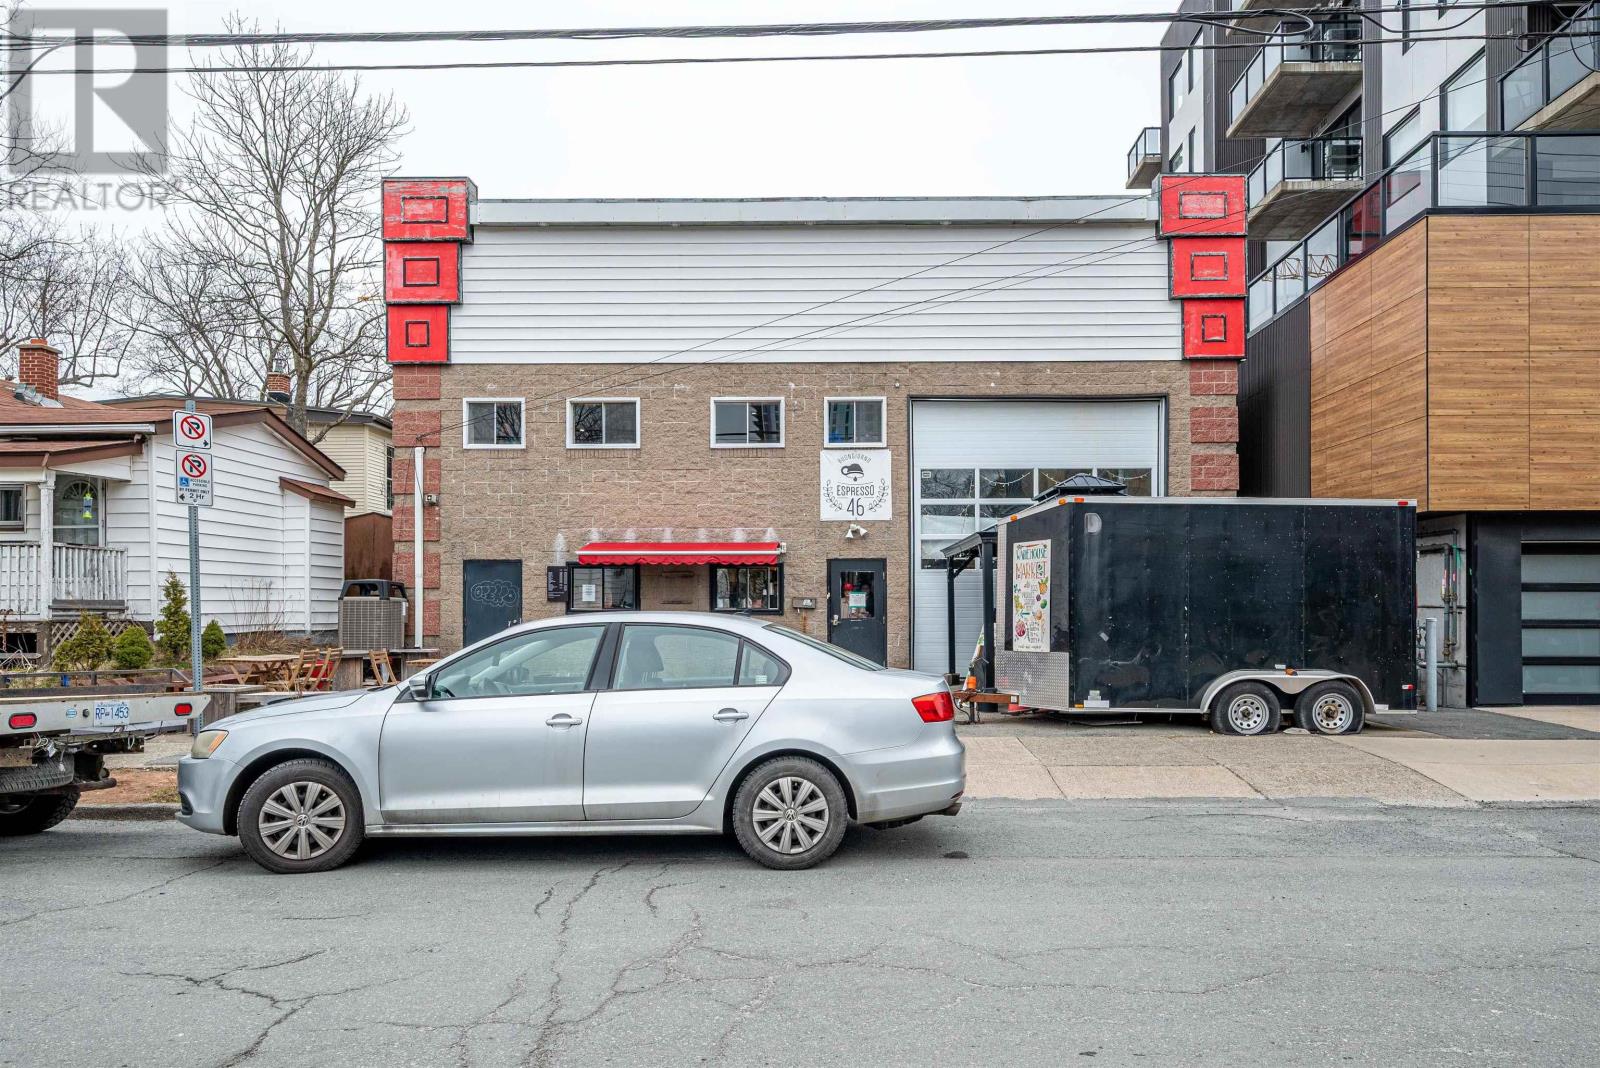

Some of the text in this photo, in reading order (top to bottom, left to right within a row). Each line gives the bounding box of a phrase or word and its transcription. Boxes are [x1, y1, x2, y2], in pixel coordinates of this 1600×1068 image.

[836, 484, 875, 496] ESPRESSO
[846, 497, 865, 516] 46
[1016, 547, 1048, 560] WAREHOUSE
[1015, 560, 1048, 580] MARKET
